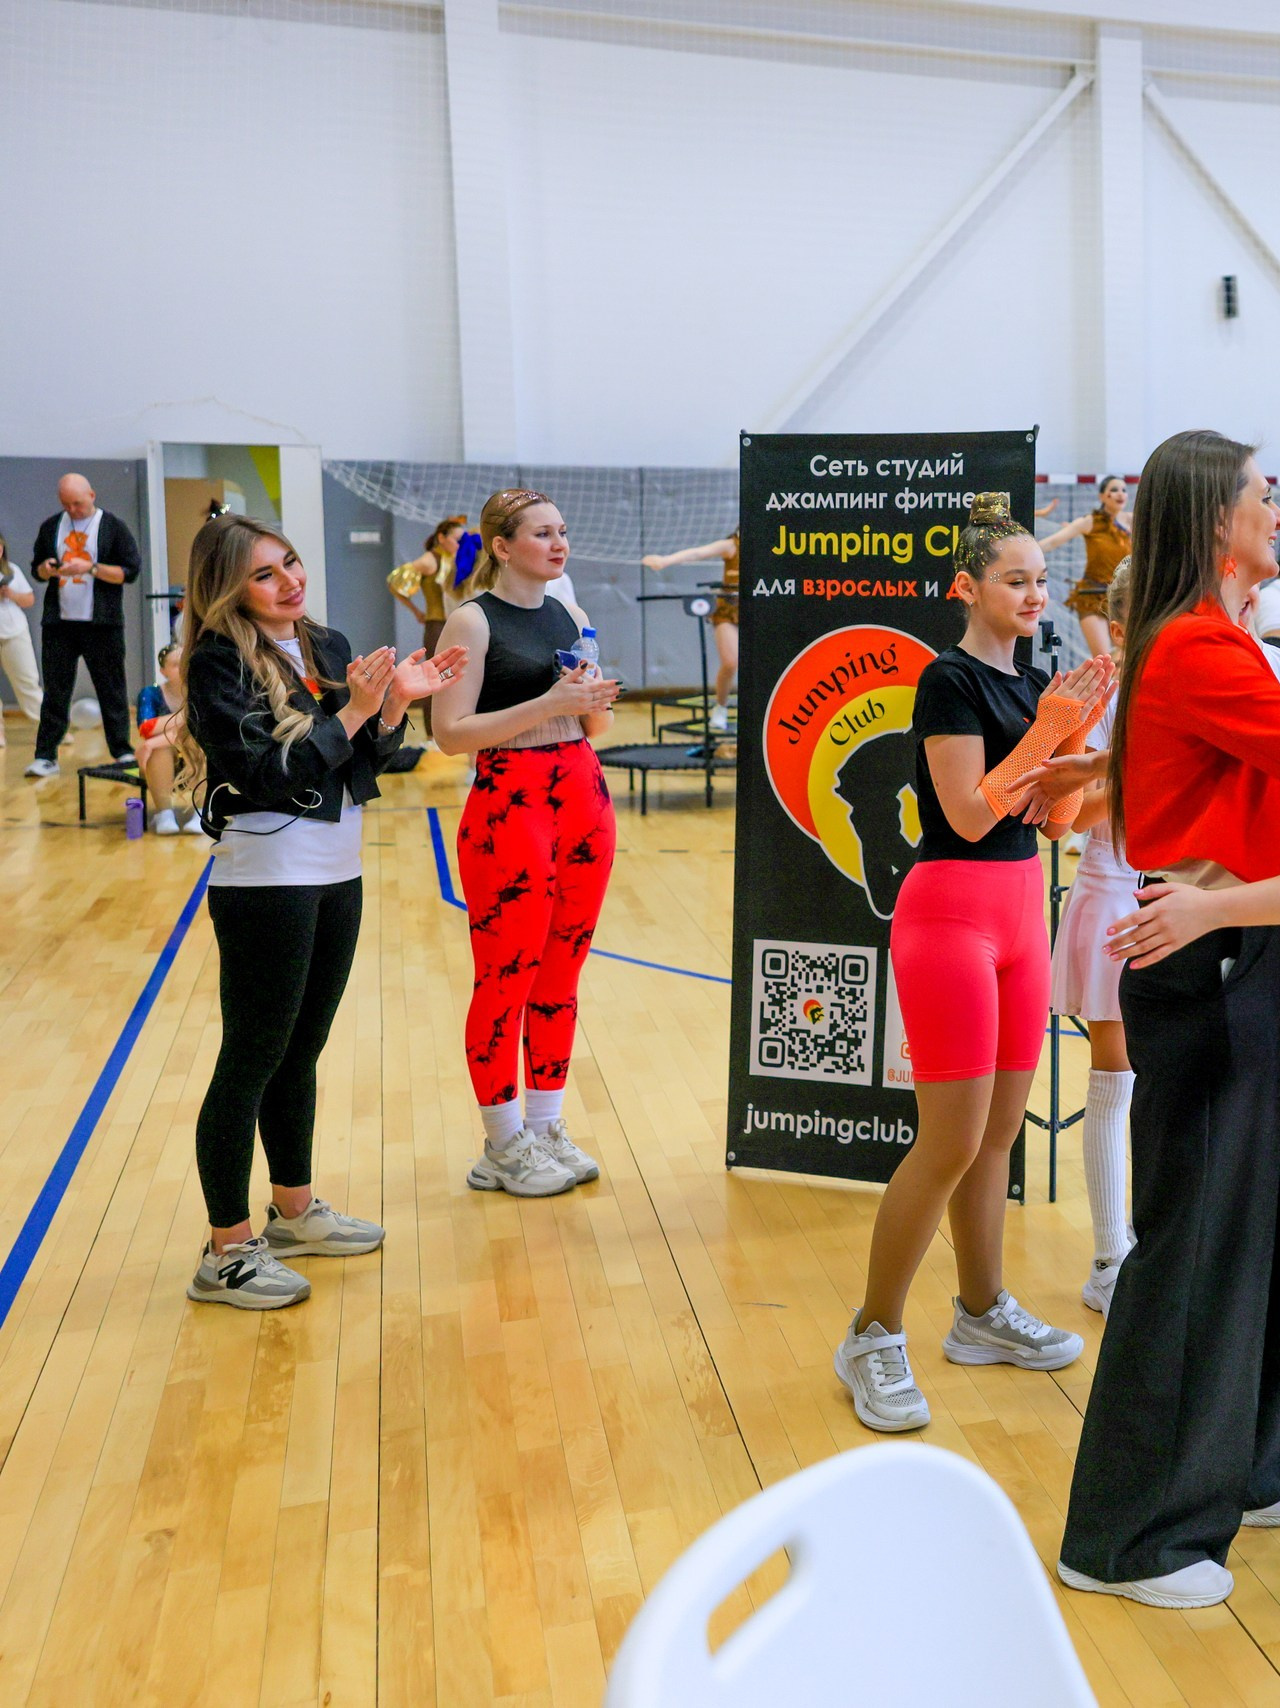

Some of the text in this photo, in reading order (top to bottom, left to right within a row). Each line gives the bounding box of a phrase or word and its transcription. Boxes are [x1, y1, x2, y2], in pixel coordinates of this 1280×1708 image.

[809, 452, 963, 481] Сеть студий
[765, 487, 1010, 513] джампинг фитне
[771, 525, 913, 564] Jumping
[752, 578, 796, 597] для
[803, 578, 918, 601] взрослых
[925, 580, 939, 597] и
[777, 643, 899, 745] Jumping
[829, 698, 886, 746] Club
[744, 1102, 915, 1145] jumpingclub
